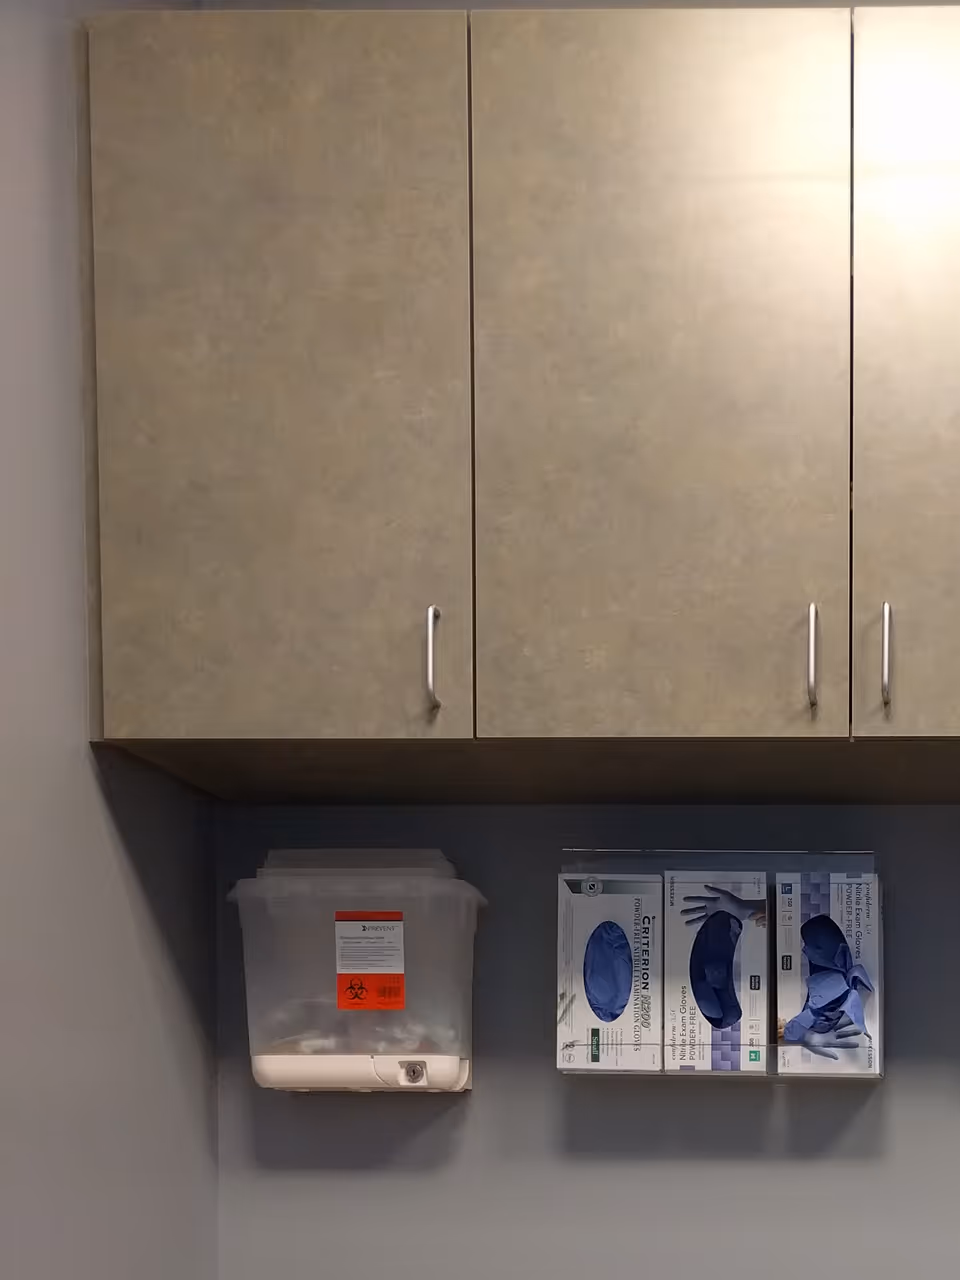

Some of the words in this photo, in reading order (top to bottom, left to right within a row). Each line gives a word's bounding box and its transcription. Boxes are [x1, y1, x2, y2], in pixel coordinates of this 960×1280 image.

[845, 883, 853, 939] POWDER-FREE
[855, 908, 863, 929] Exam
[641, 915, 651, 991] CRITERION
[855, 931, 863, 960] Gloves
[679, 985, 687, 1015] Gloves
[679, 1015, 687, 1037] Exam
[689, 1005, 697, 1061] POWDER-FREE
[679, 1038, 687, 1061] Nitrile
